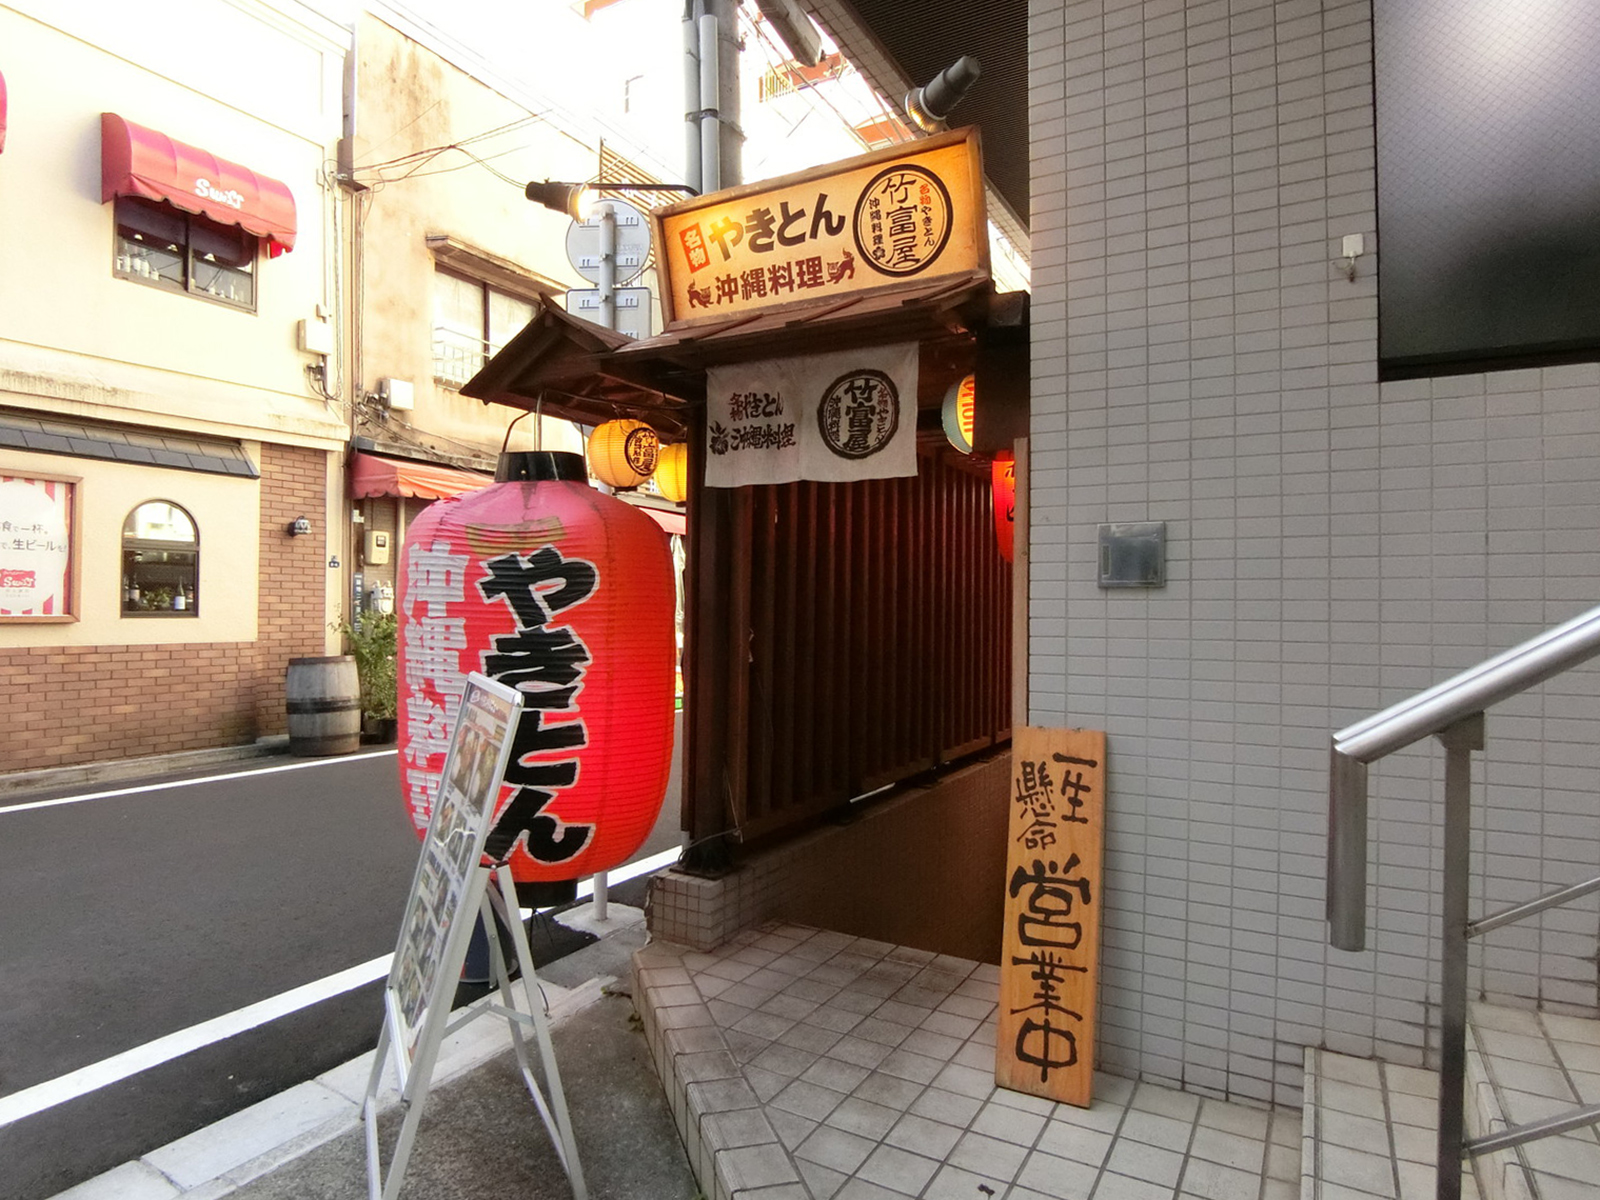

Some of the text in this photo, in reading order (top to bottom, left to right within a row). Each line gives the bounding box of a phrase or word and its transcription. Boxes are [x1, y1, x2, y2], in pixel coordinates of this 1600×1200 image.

[684, 229, 706, 268] 名物
[708, 193, 846, 262] やきとん
[868, 197, 885, 246] 沖縄料理
[881, 173, 922, 268] 竹富屋
[715, 256, 826, 306] 沖縄料理
[730, 423, 797, 451] 沖縄料理
[743, 391, 785, 419] やきとん
[842, 377, 879, 452] 竹富屋
[0, 520, 49, 535] 食で一杯。
[402, 540, 470, 830] 沖縄料理
[474, 544, 600, 865] やきとん
[1052, 752, 1098, 824] 一生
[1009, 853, 1092, 1083] 営業中
